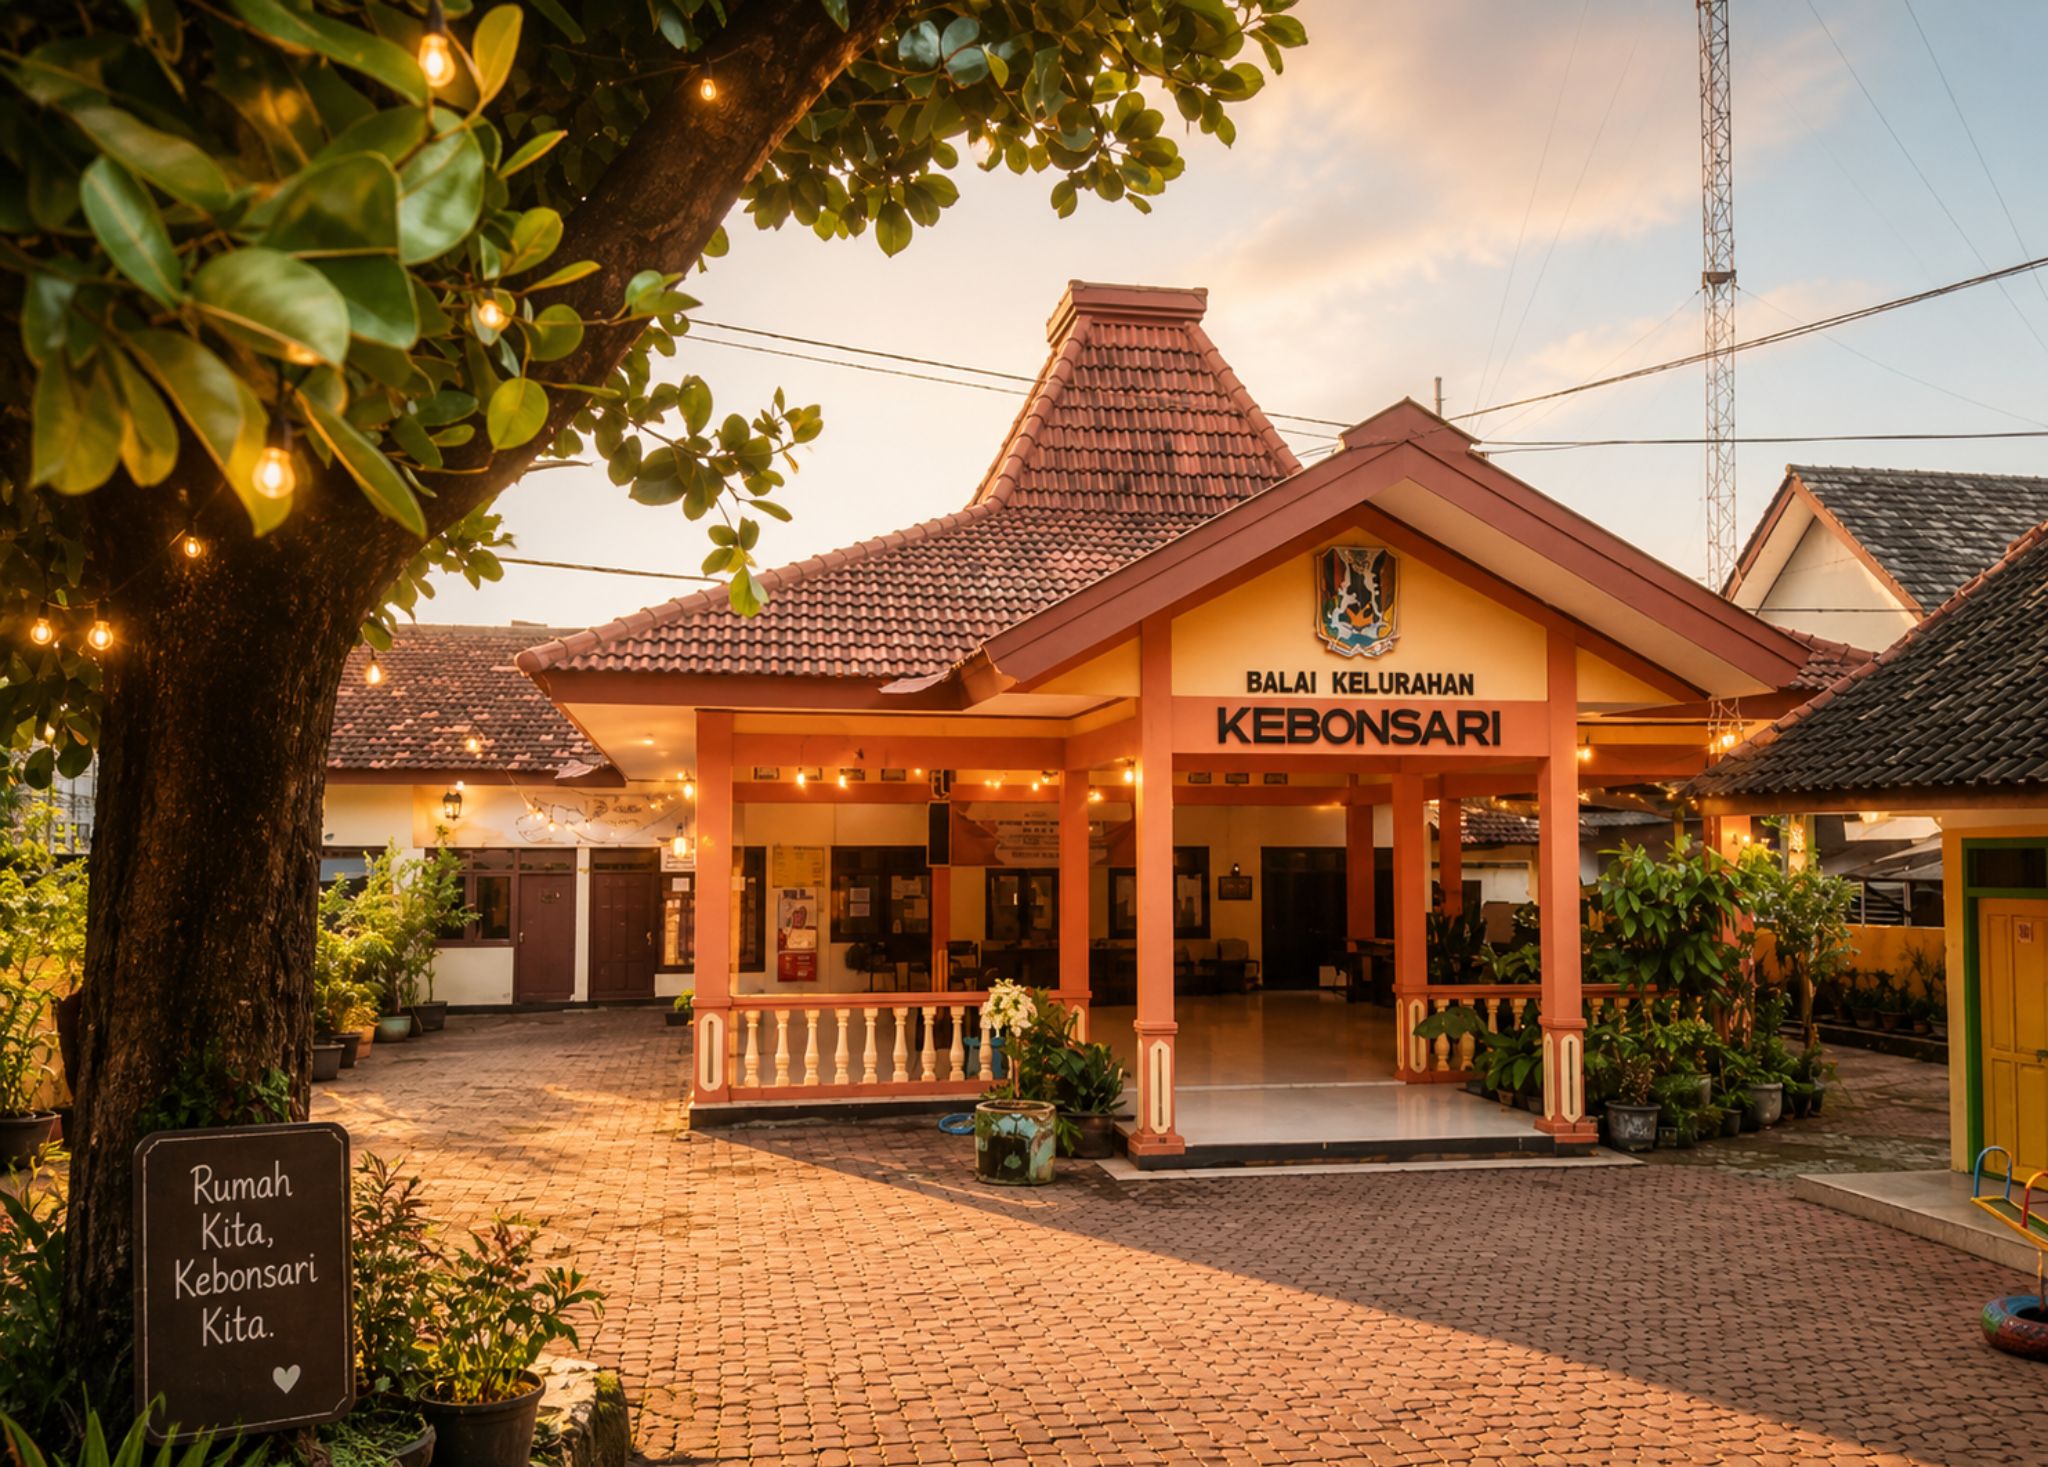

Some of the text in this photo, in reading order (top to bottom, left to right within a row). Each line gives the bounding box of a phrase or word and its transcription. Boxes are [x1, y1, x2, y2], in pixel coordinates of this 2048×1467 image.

[1247, 671, 1474, 696] BALAI KELURAHAN
[1217, 706, 1501, 747] KEBONSARI
[190, 1160, 293, 1205] Rumah
[202, 1212, 273, 1251] Kita,
[175, 1253, 319, 1300] Kebonsari
[202, 1305, 274, 1347] Kita.
